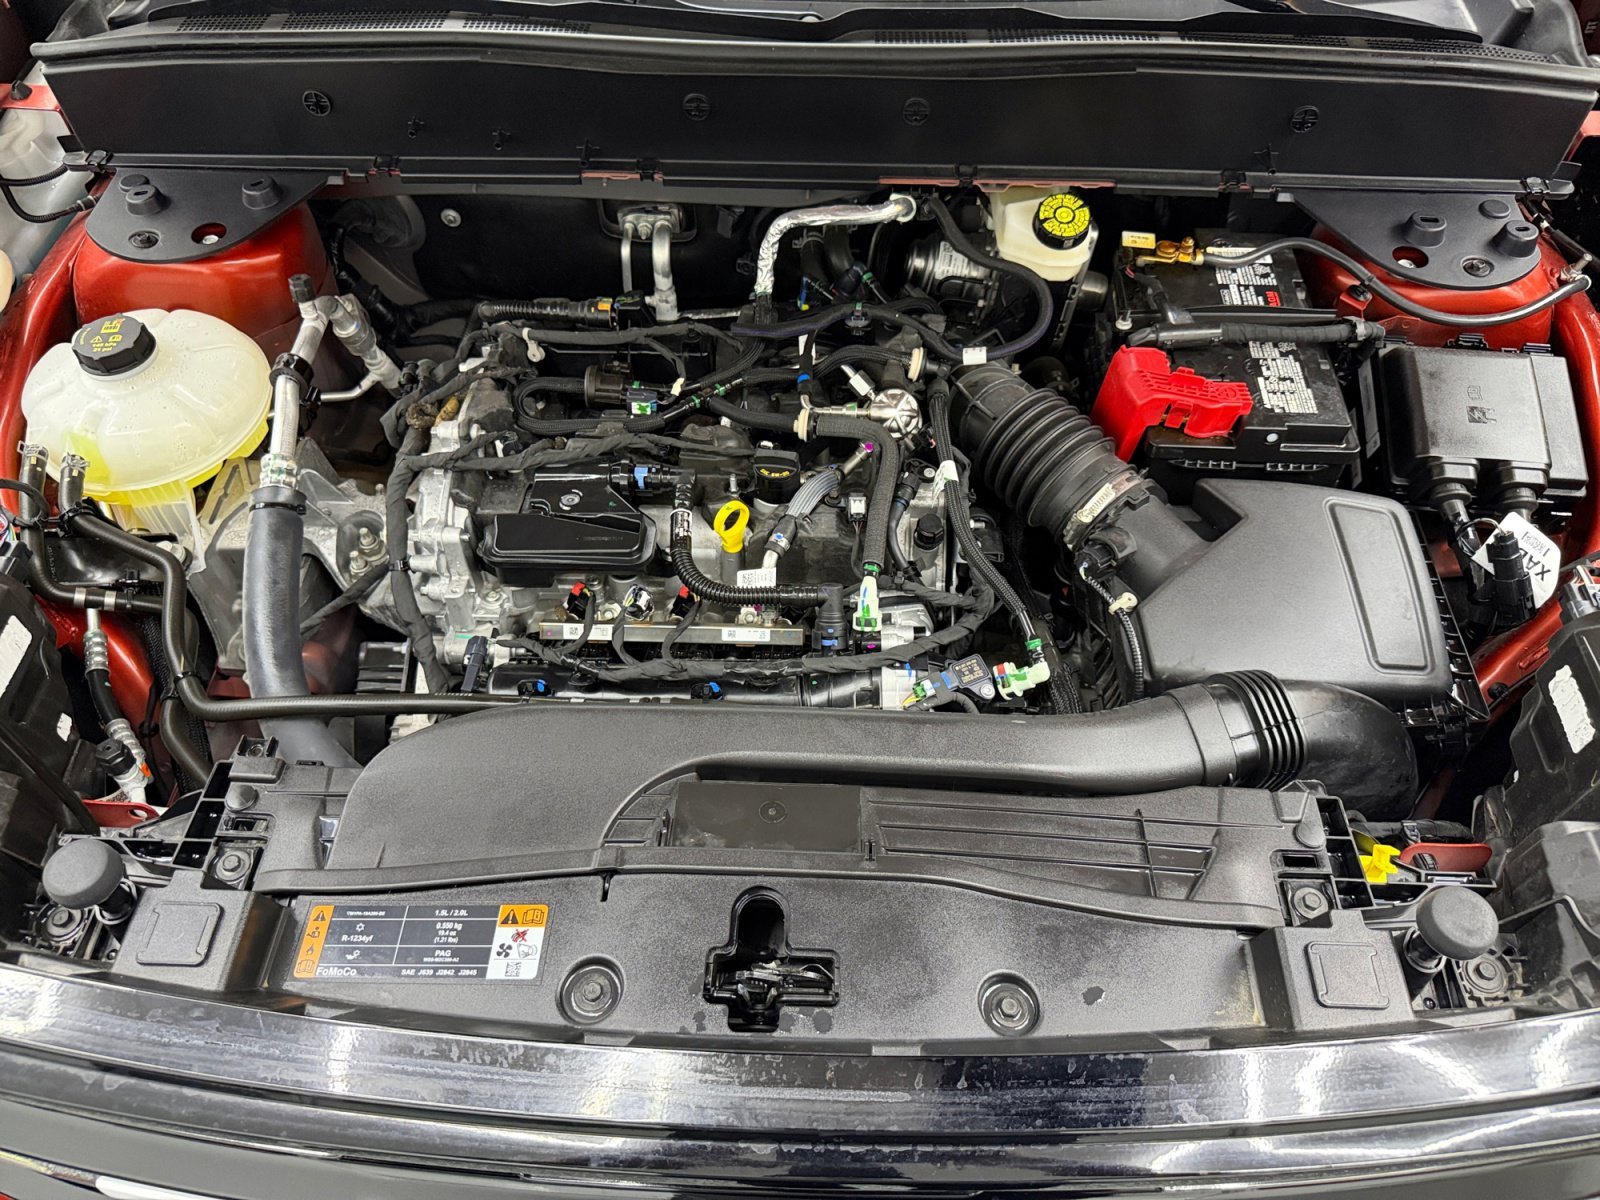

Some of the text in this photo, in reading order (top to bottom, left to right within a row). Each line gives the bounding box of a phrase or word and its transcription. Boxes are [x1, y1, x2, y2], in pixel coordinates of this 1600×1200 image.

[435, 909, 449, 917] 1.5L
[453, 909, 469, 917] 2.0L
[436, 922, 463, 931] 0.550 kg
[341, 934, 374, 944] R-1234yf
[435, 949, 452, 957] PAG
[316, 966, 357, 977] FoMoCo
[401, 968, 416, 976] SAE
[417, 968, 434, 976] J639
